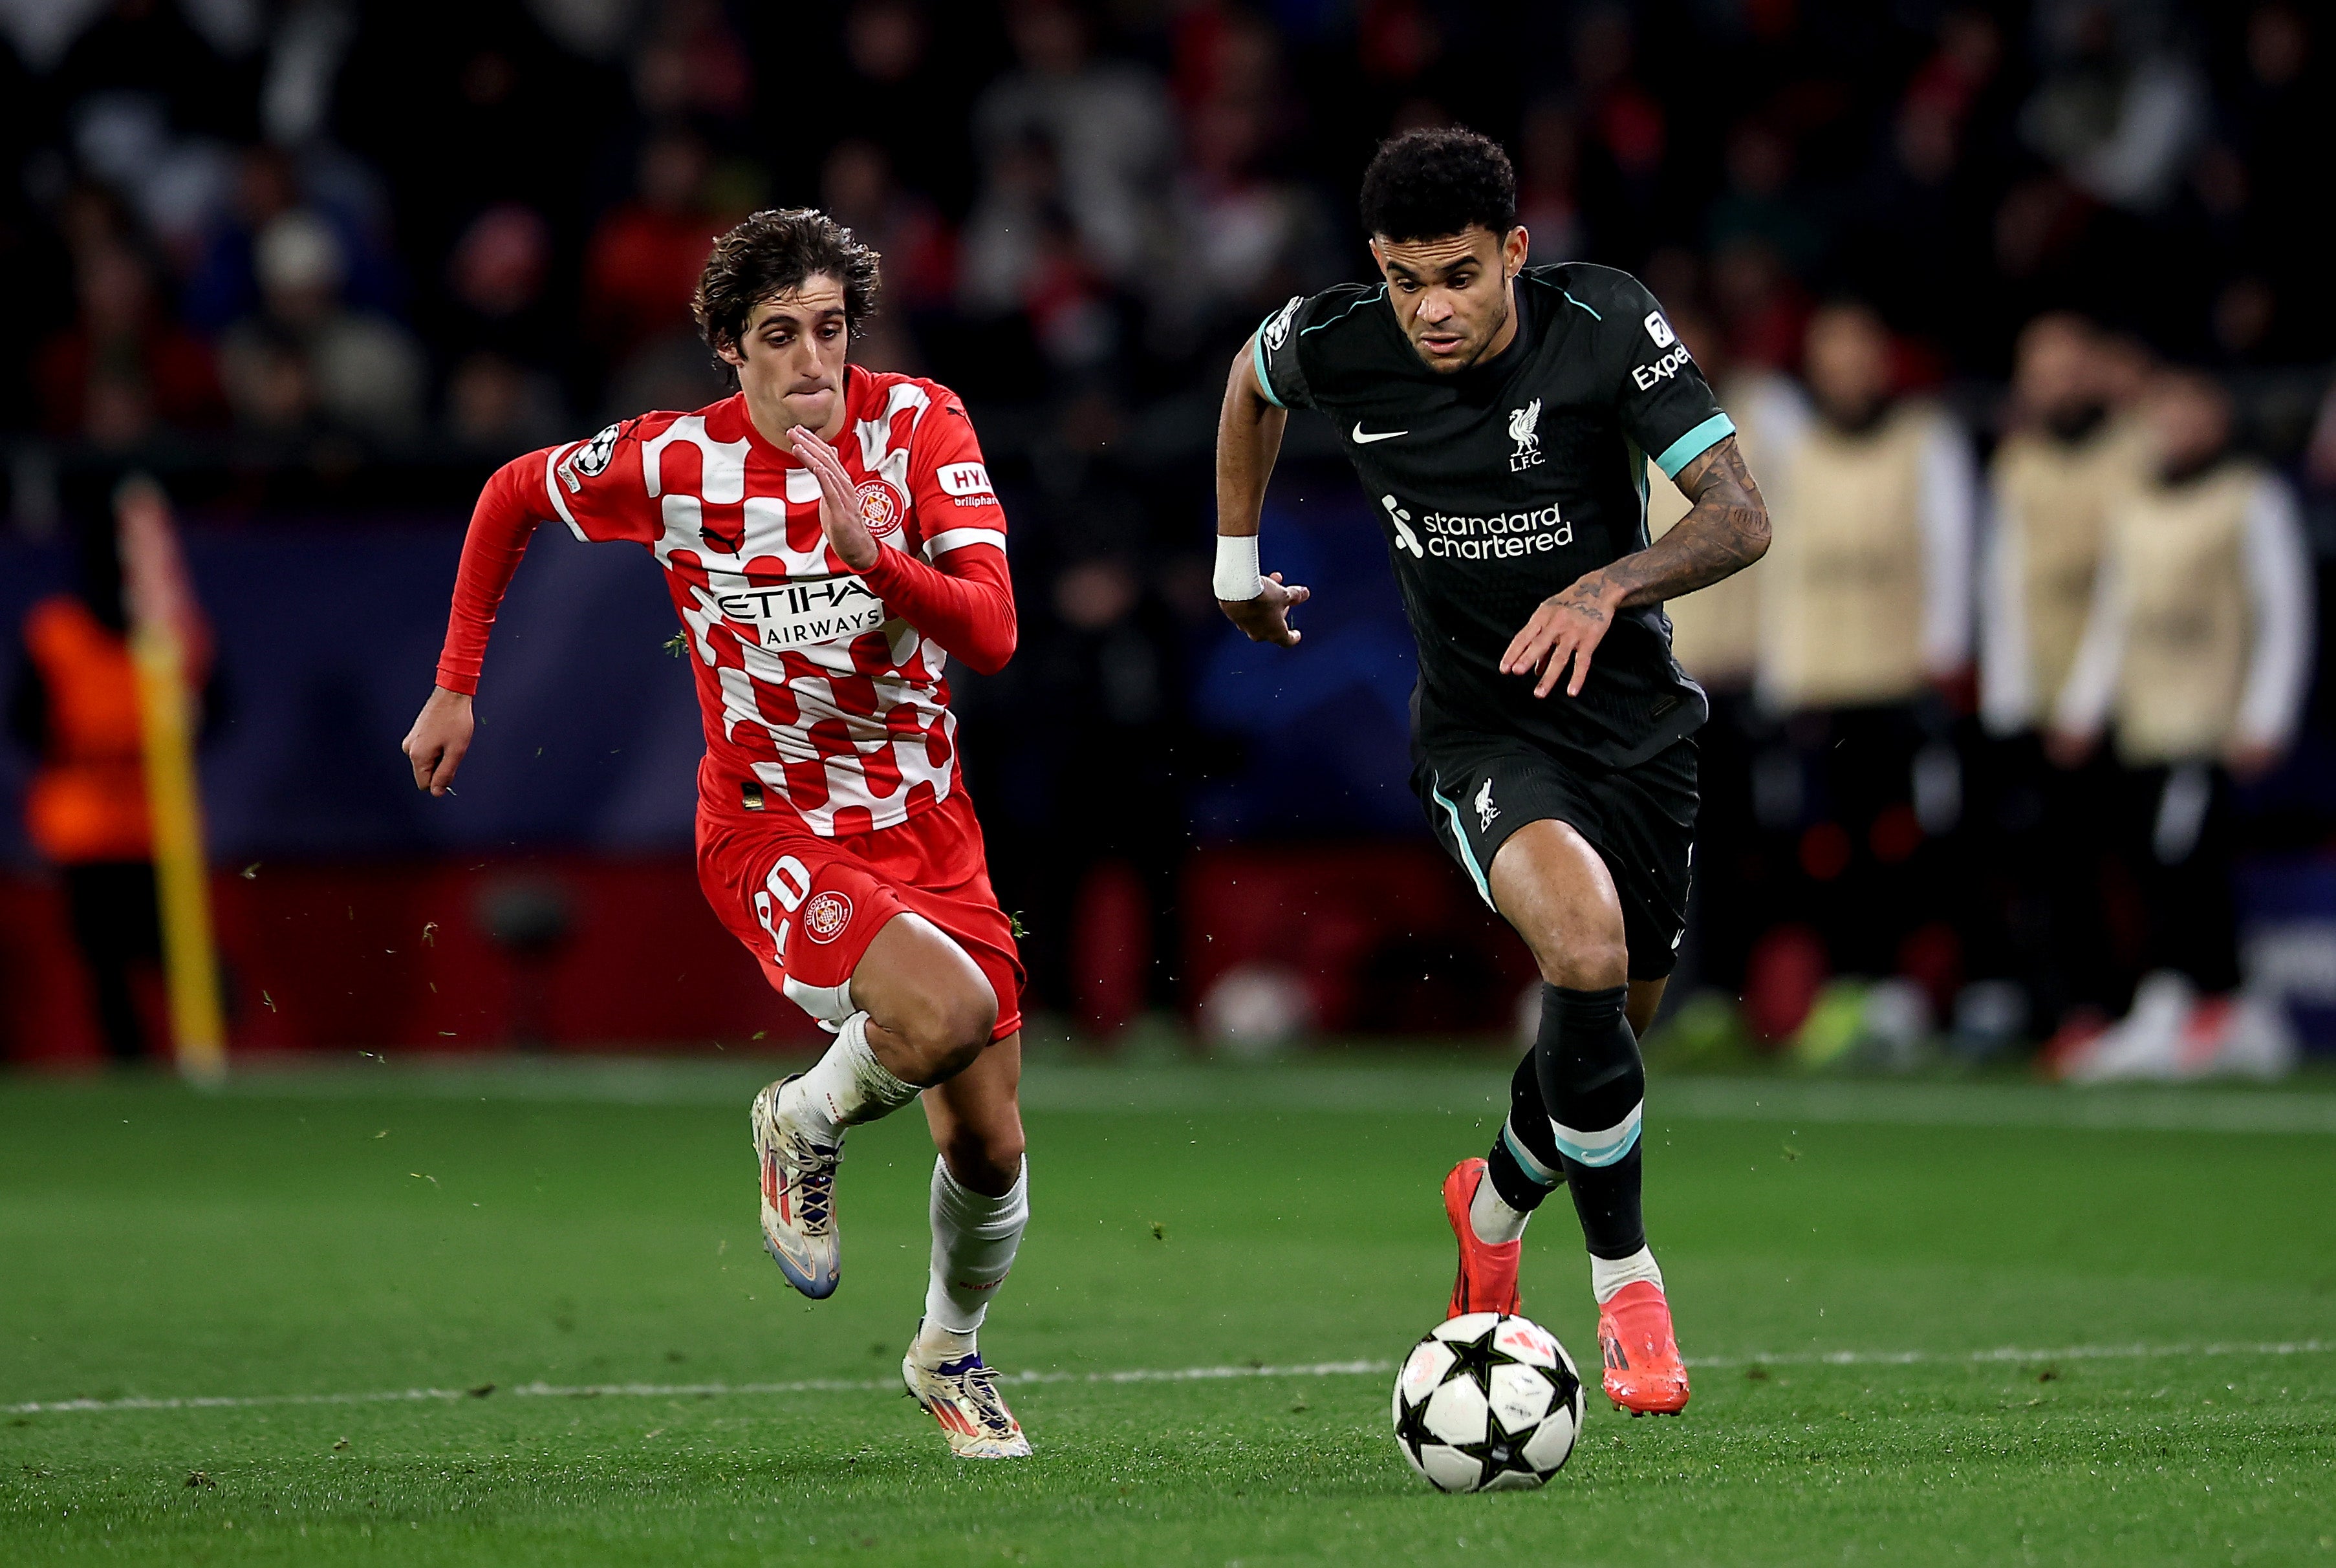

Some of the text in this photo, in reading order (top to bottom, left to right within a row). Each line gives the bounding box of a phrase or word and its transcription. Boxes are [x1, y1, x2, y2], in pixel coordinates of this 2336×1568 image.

[1509, 451, 1546, 472] L.F.C.
[1423, 502, 1561, 535] standard
[1428, 521, 1573, 559] chartered
[767, 610, 879, 645] AIRWAYS
[754, 855, 811, 967] 20
[806, 895, 828, 926] GIRONA
